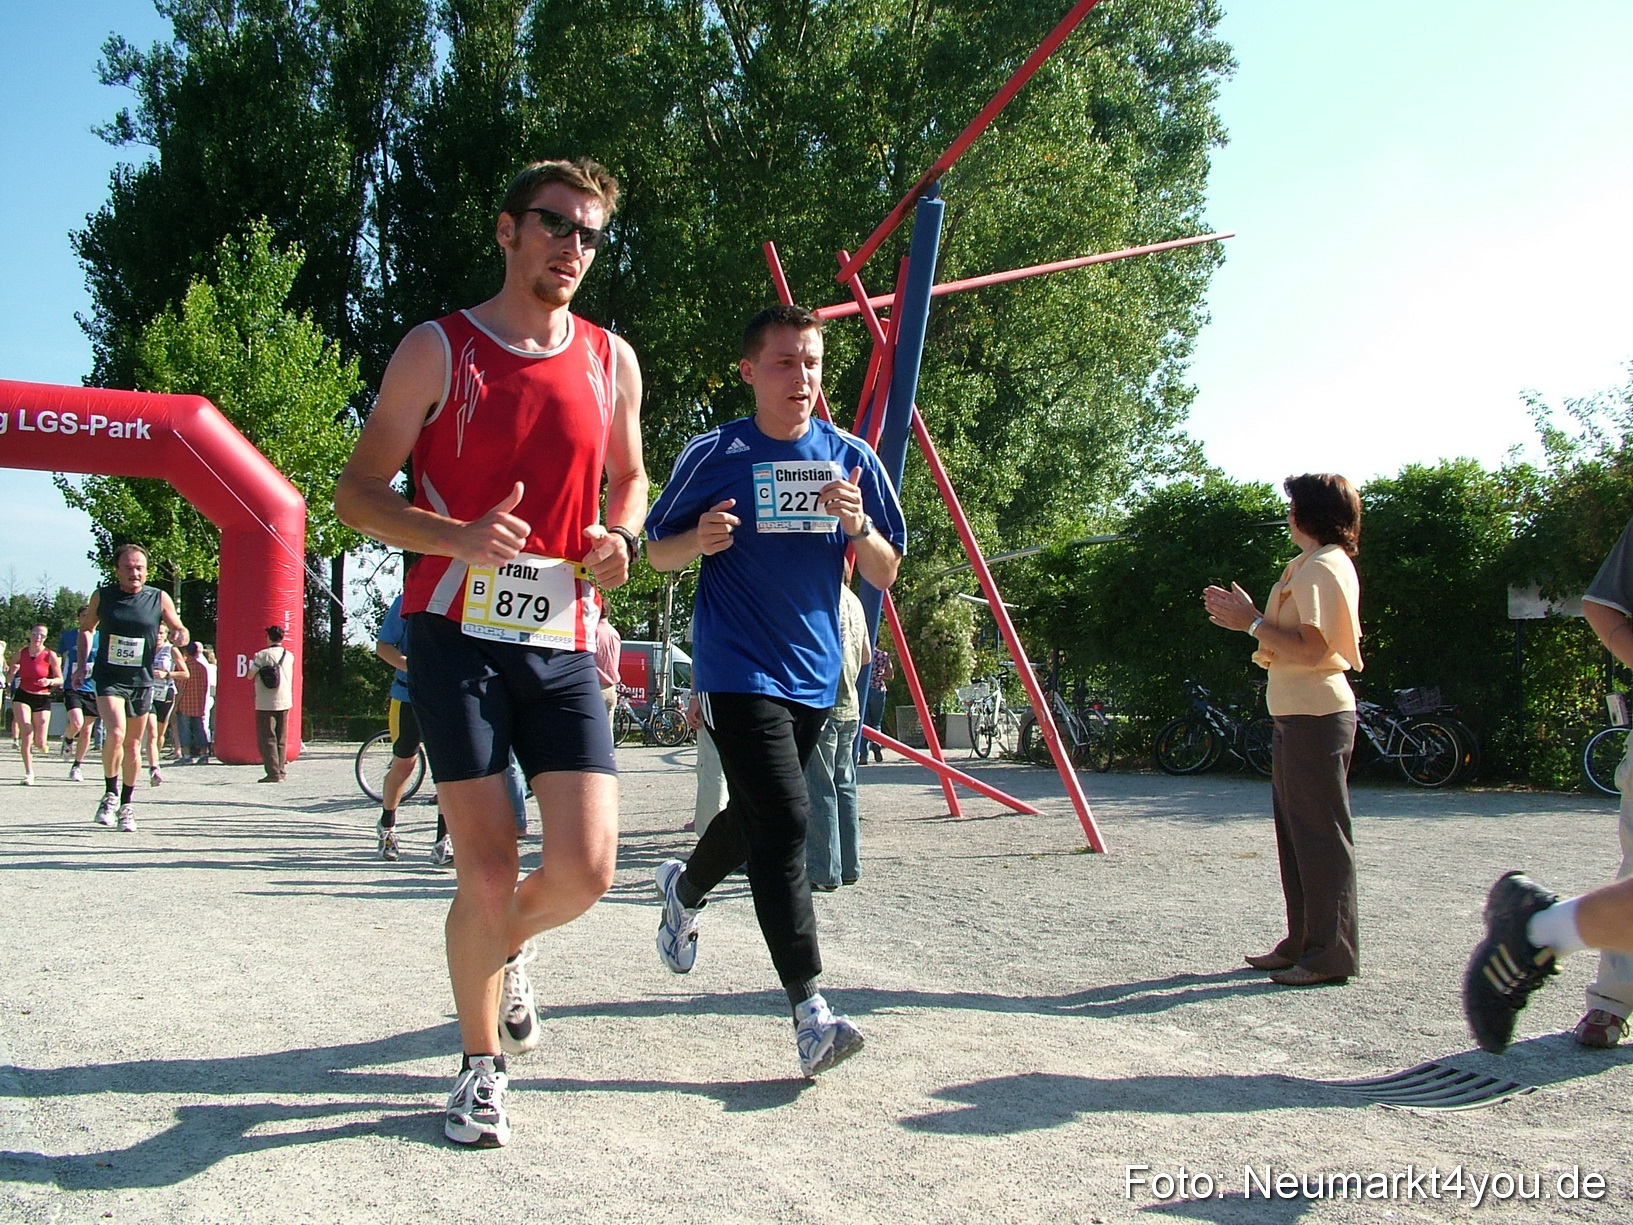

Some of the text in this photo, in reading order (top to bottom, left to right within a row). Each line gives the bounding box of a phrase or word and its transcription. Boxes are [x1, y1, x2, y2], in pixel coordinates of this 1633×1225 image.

[18, 408, 152, 440] LGS-Park
[776, 469, 832, 481] Christian
[760, 488, 769, 498] C
[780, 492, 834, 511] 227
[473, 581, 485, 595] B
[495, 590, 550, 622] 879
[531, 632, 573, 645] PFLEIDERER
[116, 648, 135, 659] 854
